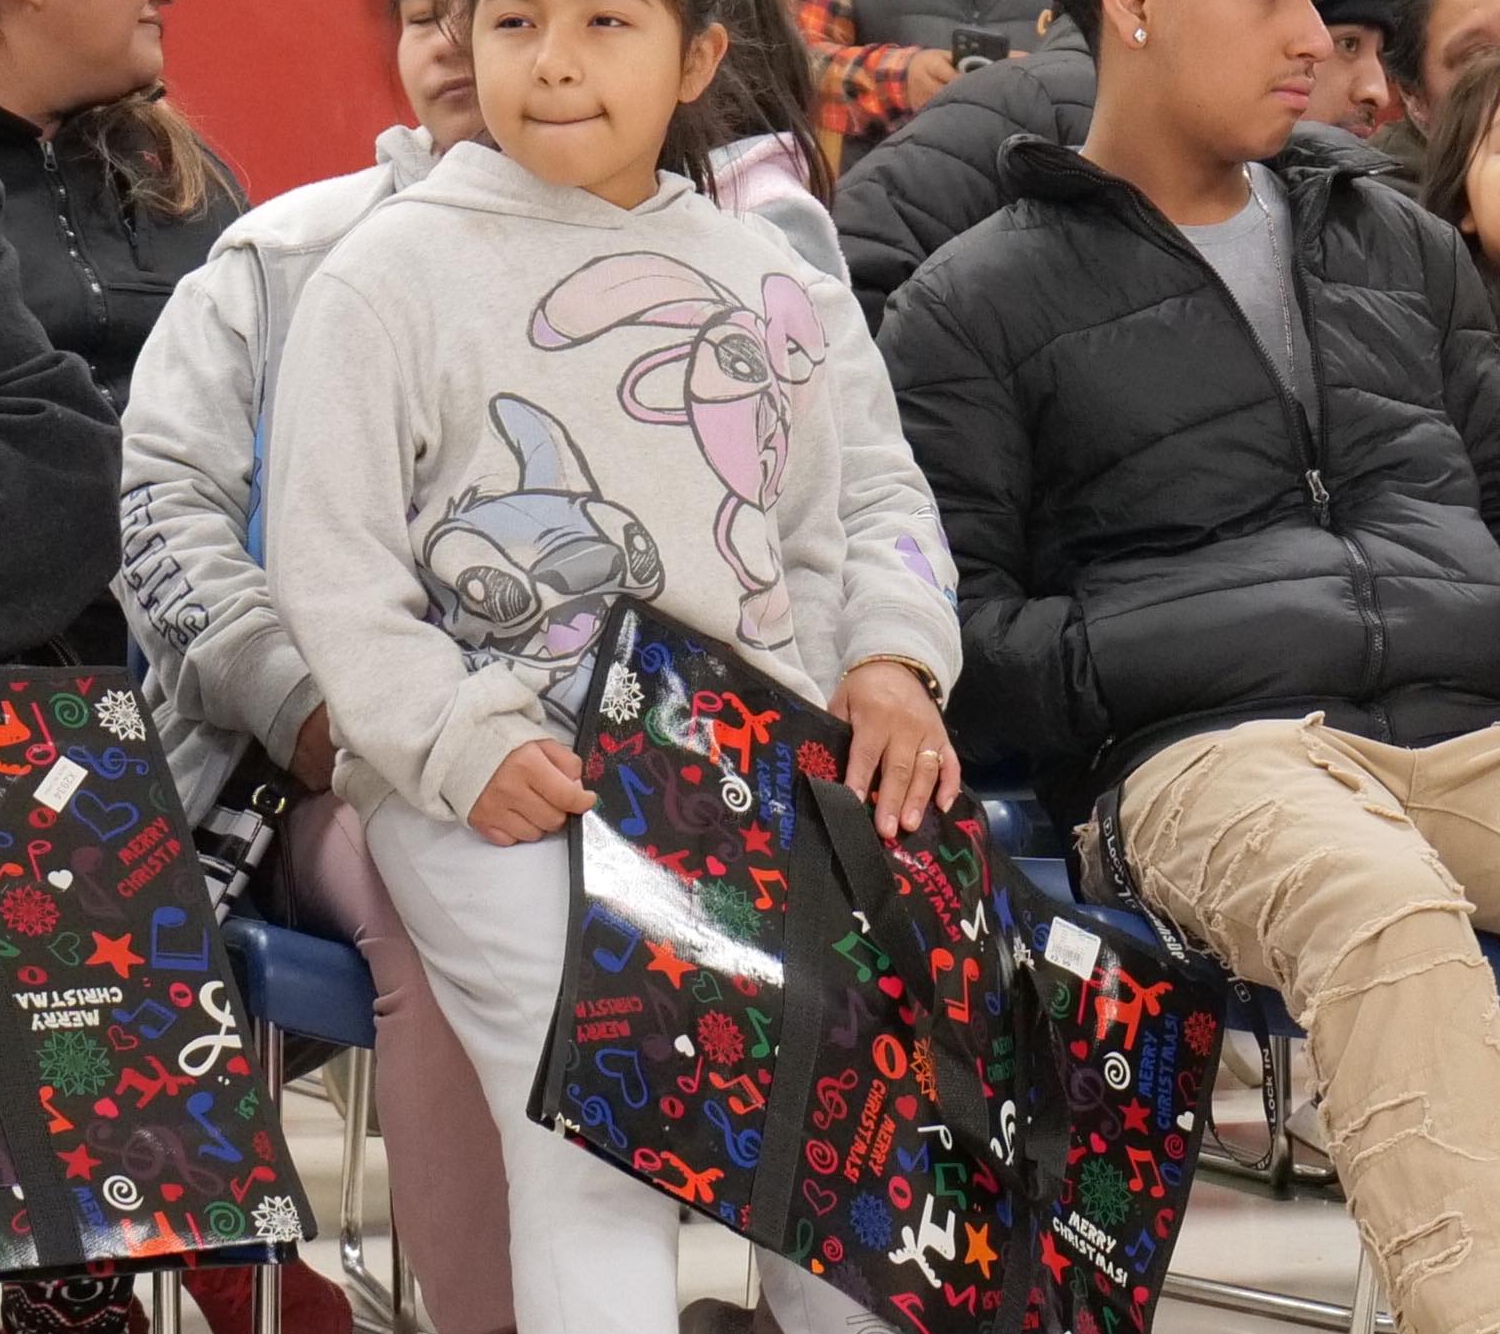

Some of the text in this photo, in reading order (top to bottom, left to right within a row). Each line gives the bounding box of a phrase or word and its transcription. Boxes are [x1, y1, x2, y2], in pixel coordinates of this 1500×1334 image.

[117, 816, 170, 866] MERRY
[31, 1009, 100, 1032] MERRY
[1137, 1030, 1159, 1098] MERRY
[868, 1114, 897, 1178] MERRY
[1051, 1216, 1129, 1289] CHRISTMAS!
[1067, 1210, 1118, 1255] MERRY
